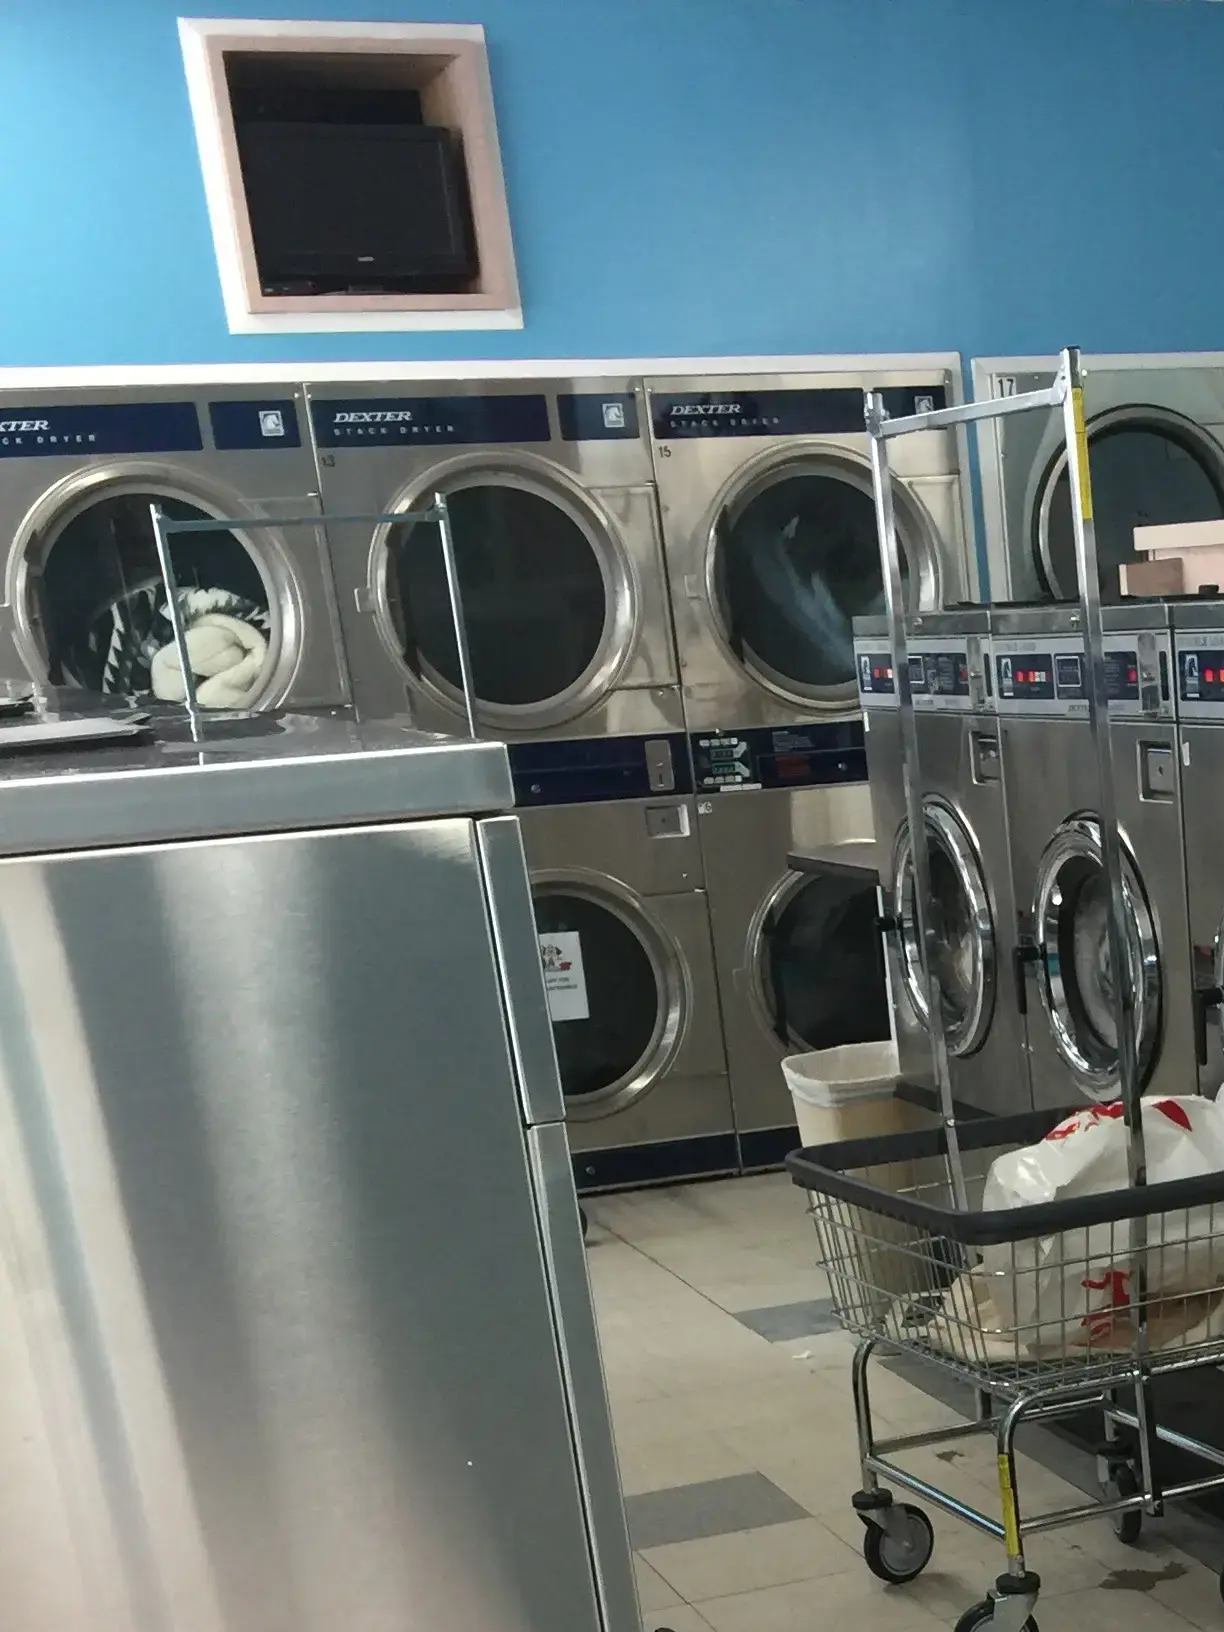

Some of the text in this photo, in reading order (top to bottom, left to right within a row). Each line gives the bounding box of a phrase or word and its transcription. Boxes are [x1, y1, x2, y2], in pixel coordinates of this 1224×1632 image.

[998, 379, 1014, 398] 17
[670, 404, 741, 416] DEXTER
[333, 411, 413, 423] DEXTER
[333, 425, 455, 436] STACK DRYER
[36, 434, 96, 444] DRYER
[659, 446, 671, 458] 15
